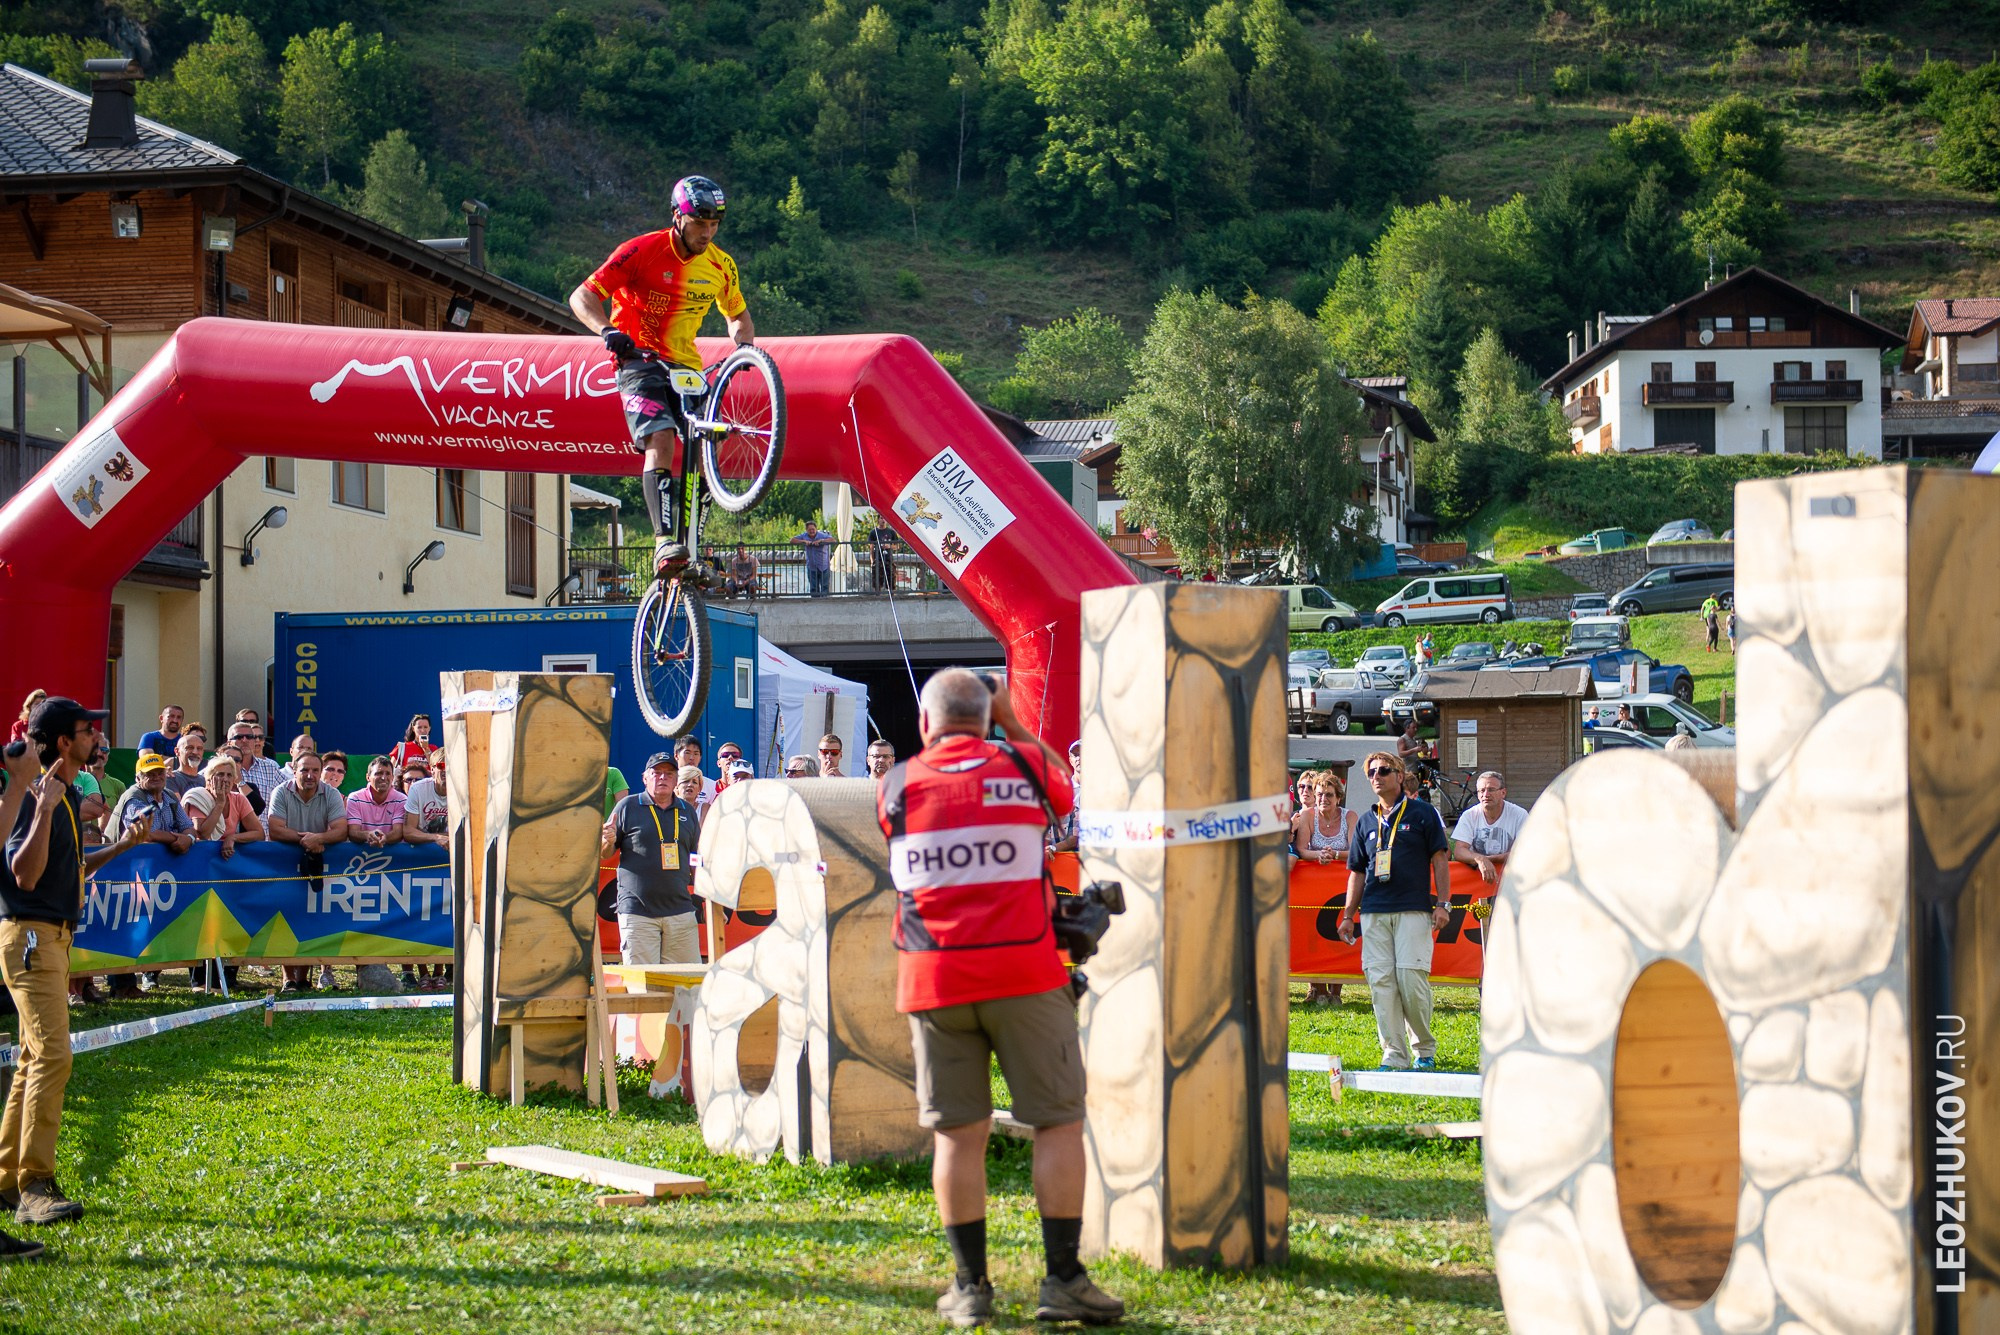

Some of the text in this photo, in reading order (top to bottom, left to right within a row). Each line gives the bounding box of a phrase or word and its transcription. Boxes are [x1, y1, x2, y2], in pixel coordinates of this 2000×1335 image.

[685, 376, 694, 387] 4
[441, 404, 555, 429] VACANZE
[374, 431, 640, 455] www.vermigliovacanze.it
[926, 468, 989, 536] Bacino Imbrifero Montano
[932, 453, 996, 530] BIM dell'Adige
[661, 491, 671, 529] JITSIE
[344, 609, 607, 626] www.containex.com
[296, 643, 318, 751] CONTAI
[1079, 825, 1113, 841] ENTINO
[1185, 812, 1261, 839] TRENTINO
[907, 840, 1016, 873] PHOTO
